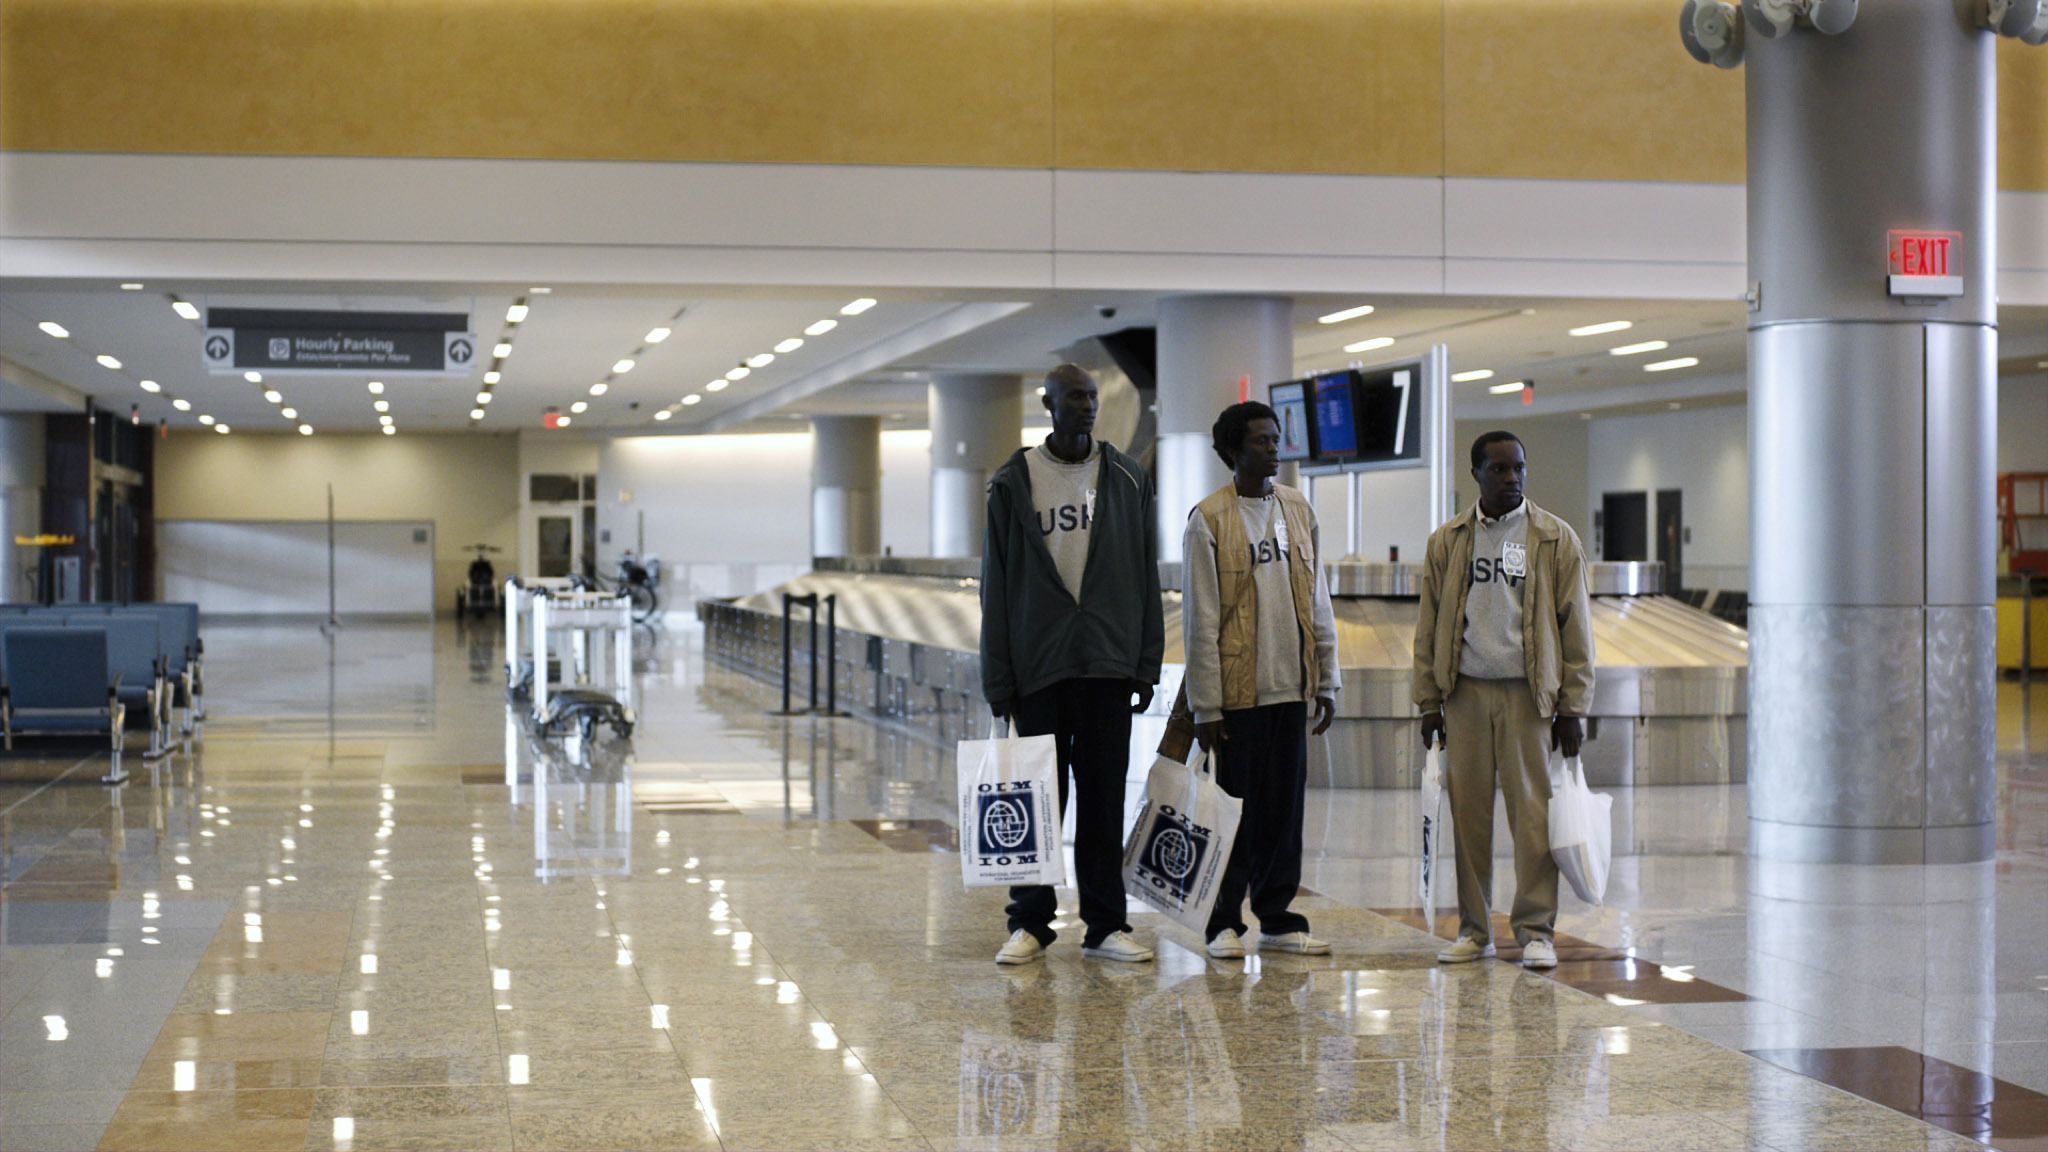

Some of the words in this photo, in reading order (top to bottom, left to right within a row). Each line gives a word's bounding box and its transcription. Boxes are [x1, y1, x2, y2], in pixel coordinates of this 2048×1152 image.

[1902, 237, 1949, 276] EXIT
[295, 337, 339, 352] Hourly
[344, 337, 394, 353] Parking
[1392, 370, 1411, 455] 7
[978, 780, 1032, 793] OIM
[1160, 804, 1212, 837] OIM
[979, 854, 1038, 866] IOM
[1135, 866, 1188, 903] IOM
